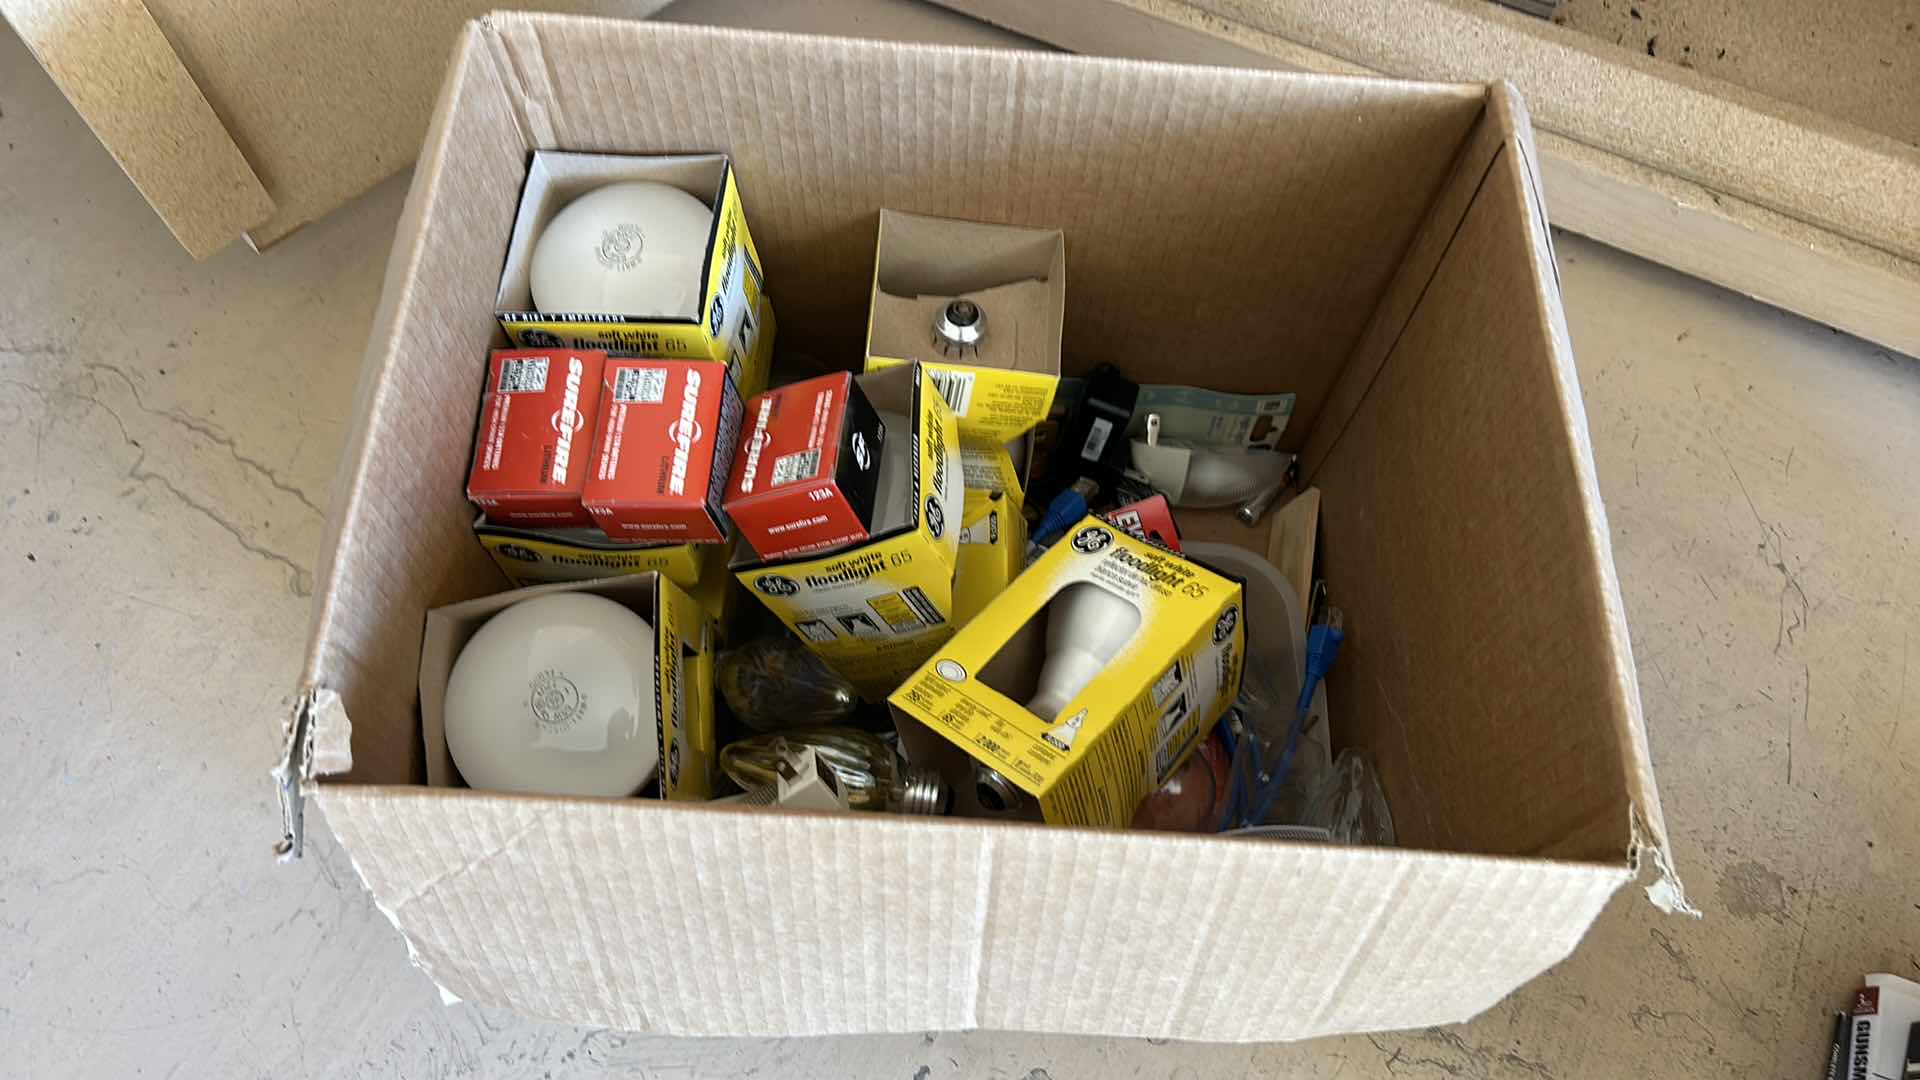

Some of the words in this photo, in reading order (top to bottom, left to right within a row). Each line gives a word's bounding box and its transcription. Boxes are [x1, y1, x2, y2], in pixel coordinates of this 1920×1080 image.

[573, 336, 659, 351] floodlight
[665, 338, 688, 351] 65
[552, 357, 583, 485] SUREFIRE
[669, 368, 701, 496] SUREFIRE
[741, 397, 772, 494] SUREFIRE
[933, 420, 945, 495] floodlight
[808, 487, 834, 502] 123A
[804, 561, 887, 589] floodlight
[890, 550, 913, 568] 65
[825, 559, 854, 574] soft
[853, 551, 884, 569] white
[1109, 546, 1185, 588] floodlight
[1182, 581, 1209, 599] 65
